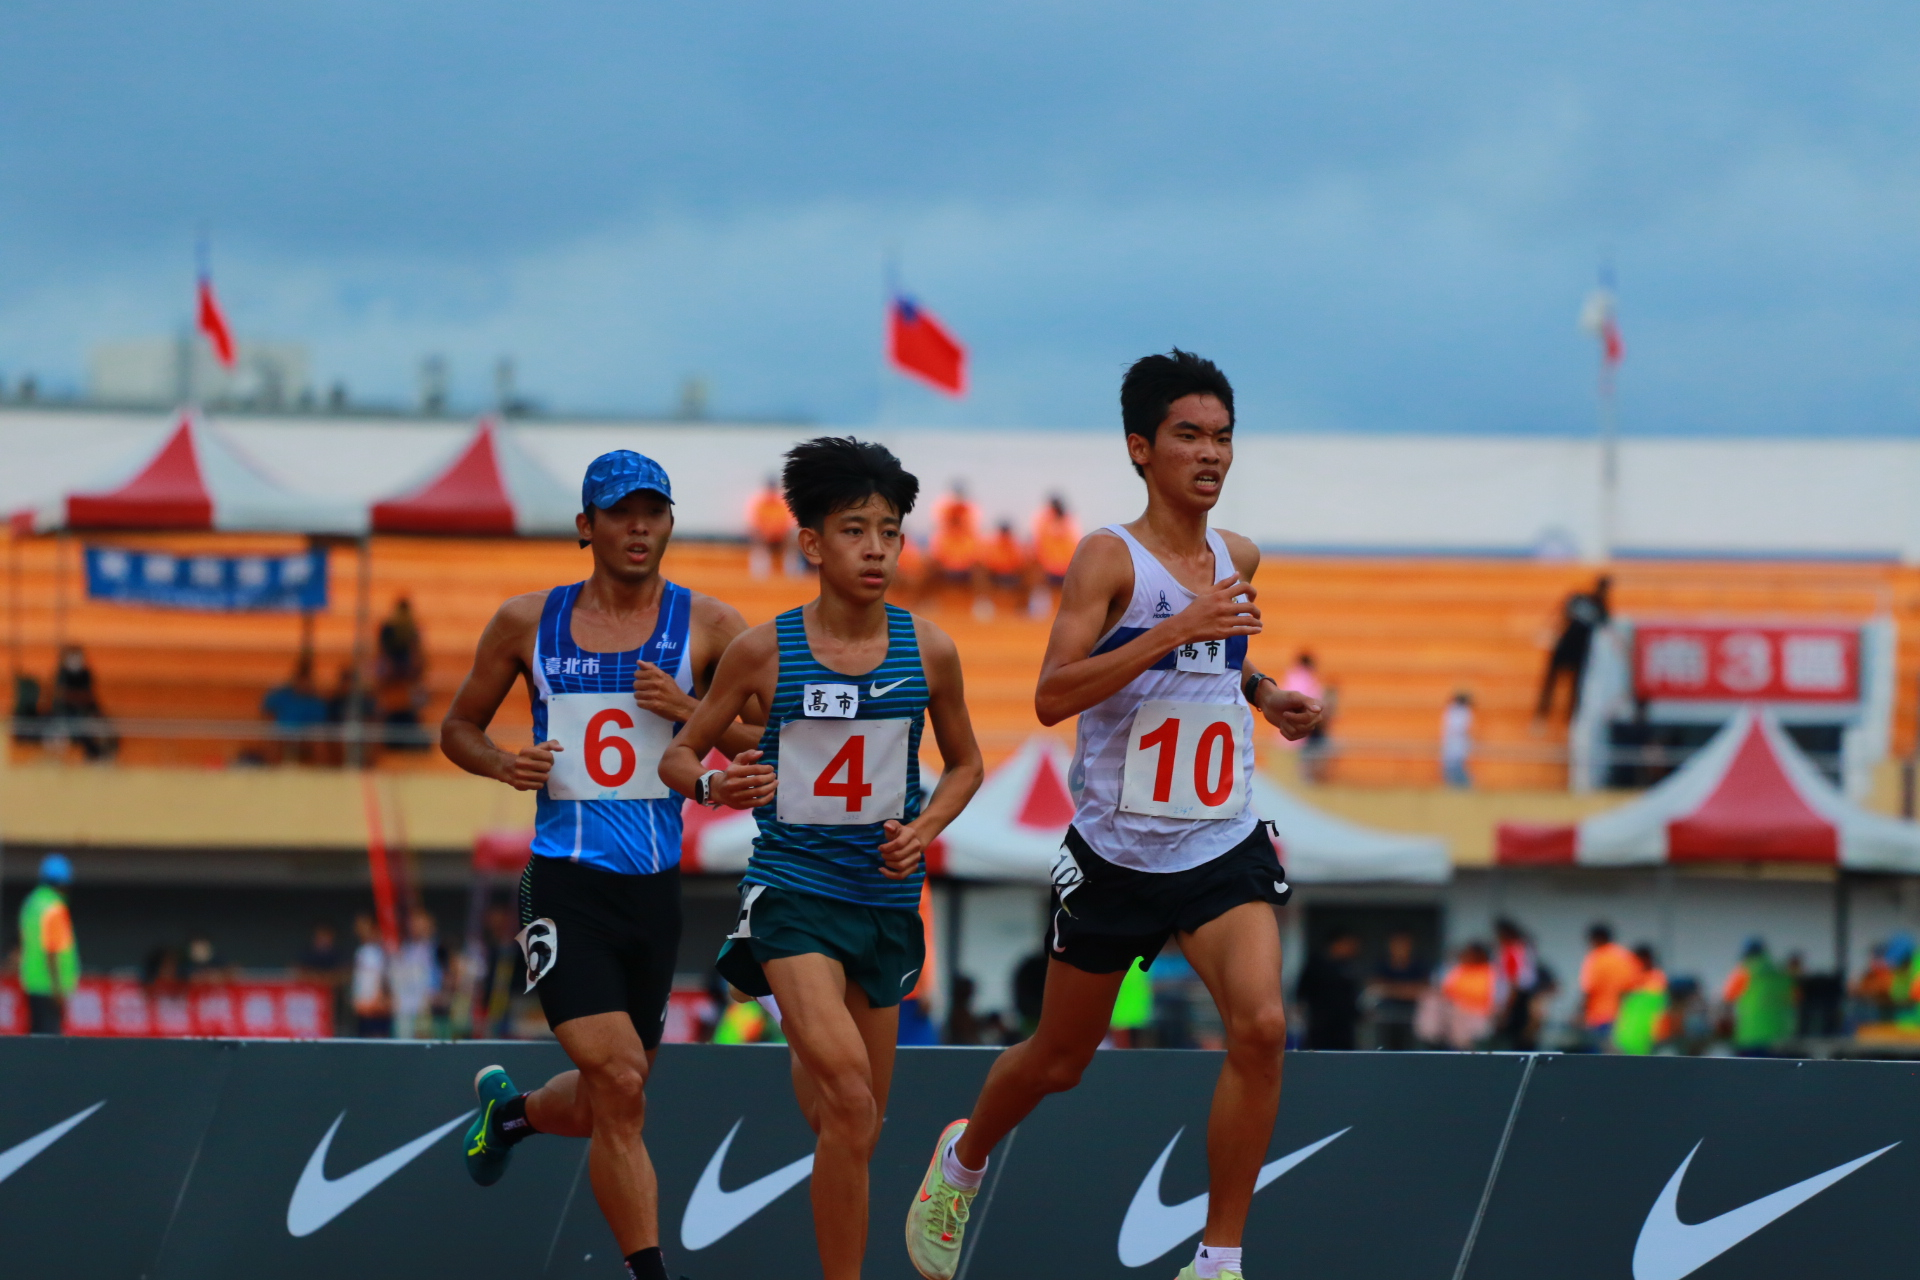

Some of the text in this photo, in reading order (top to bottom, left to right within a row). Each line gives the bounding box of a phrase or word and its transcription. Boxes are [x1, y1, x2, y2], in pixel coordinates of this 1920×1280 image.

[545, 657, 600, 675] 臺北市
[808, 689, 854, 715] 高市
[583, 708, 636, 787] 6
[814, 735, 872, 812] 4
[1139, 717, 1235, 807] 10
[526, 923, 552, 982] 6
